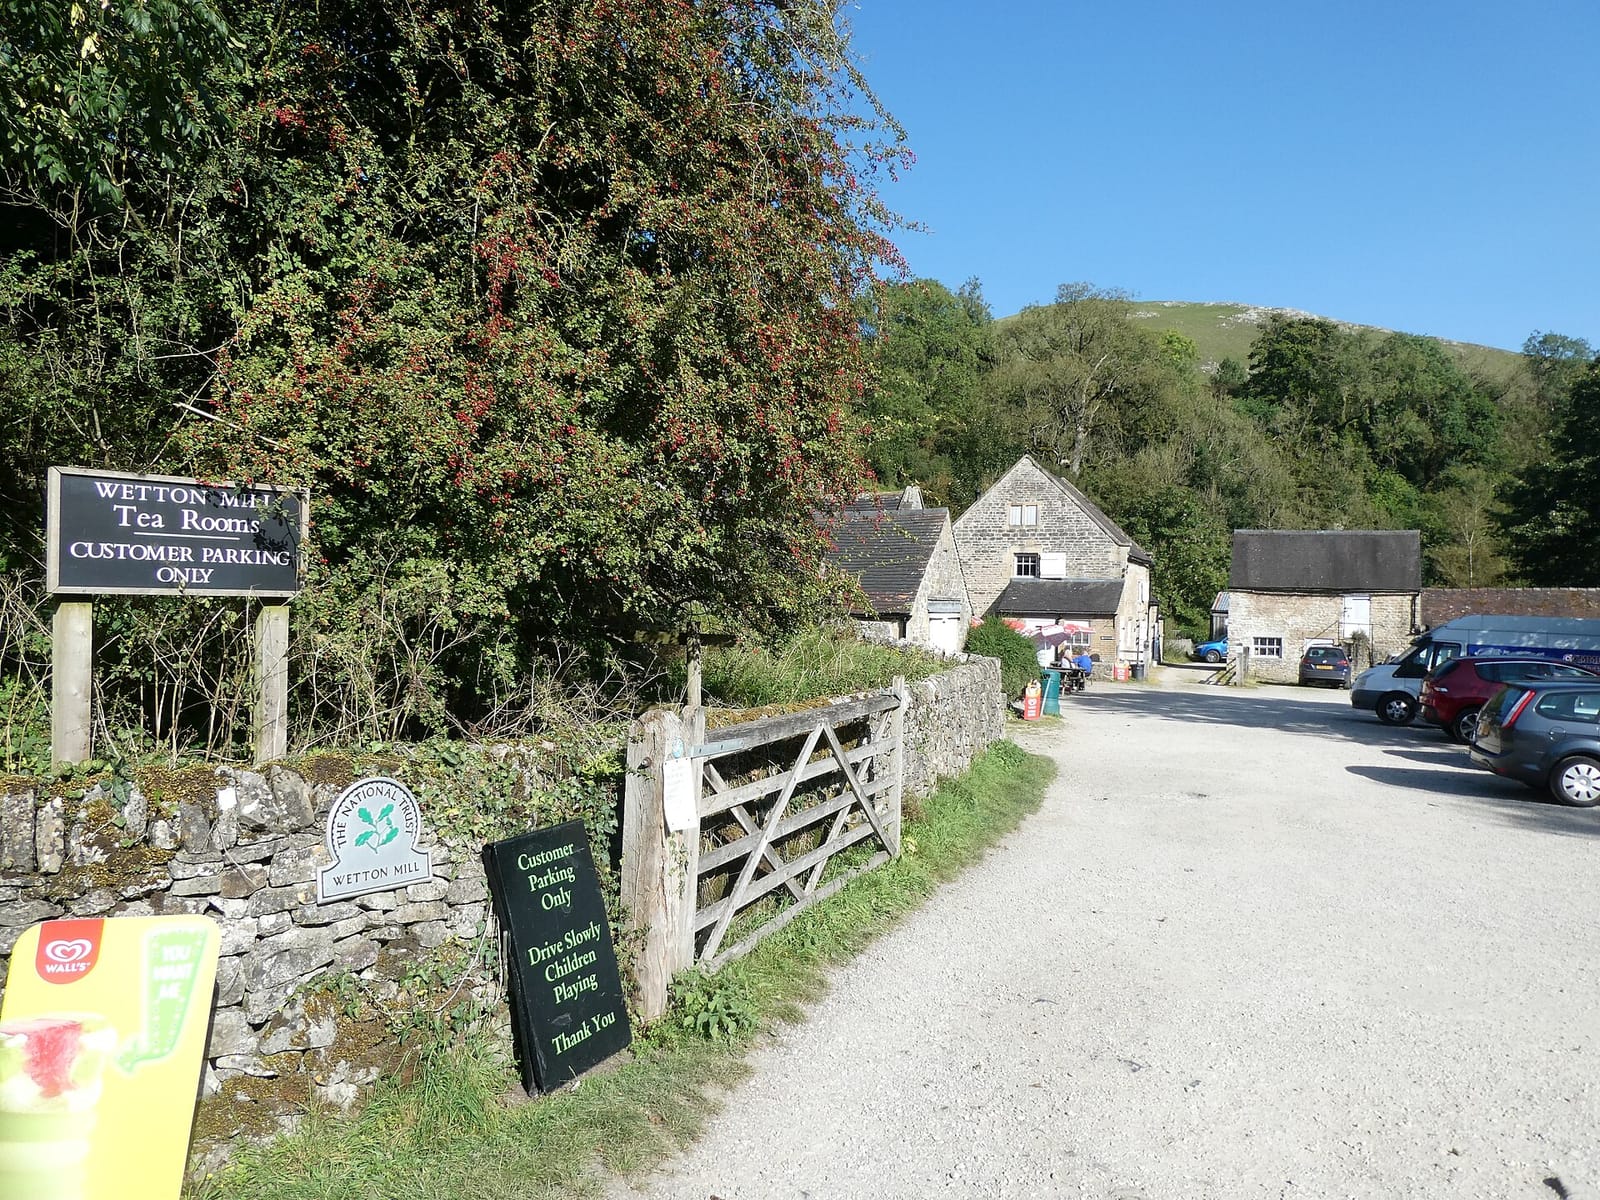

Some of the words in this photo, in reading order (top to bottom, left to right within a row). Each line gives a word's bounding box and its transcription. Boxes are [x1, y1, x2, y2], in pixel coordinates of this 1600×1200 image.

[94, 481, 206, 505] WETTON
[113, 504, 165, 528] Tea
[181, 509, 260, 534] Rooms
[70, 541, 195, 562] CUSTOMER
[202, 548, 290, 566] PARKING
[157, 567, 215, 584] ONLY
[336, 821, 347, 849] THE
[342, 786, 397, 817] NATIONAL
[398, 797, 414, 837] TRUST
[517, 843, 574, 871] Customer
[333, 867, 388, 886] WETTON
[394, 862, 420, 875] MILL
[528, 866, 576, 892] Parking
[541, 887, 572, 911] Only
[528, 941, 564, 966] Drive
[564, 921, 601, 949] Slowly
[45, 962, 87, 973] WALL'S
[544, 950, 597, 982] Children
[553, 973, 598, 1004] Playing
[551, 1021, 592, 1055] Thank
[591, 1011, 616, 1033] You
